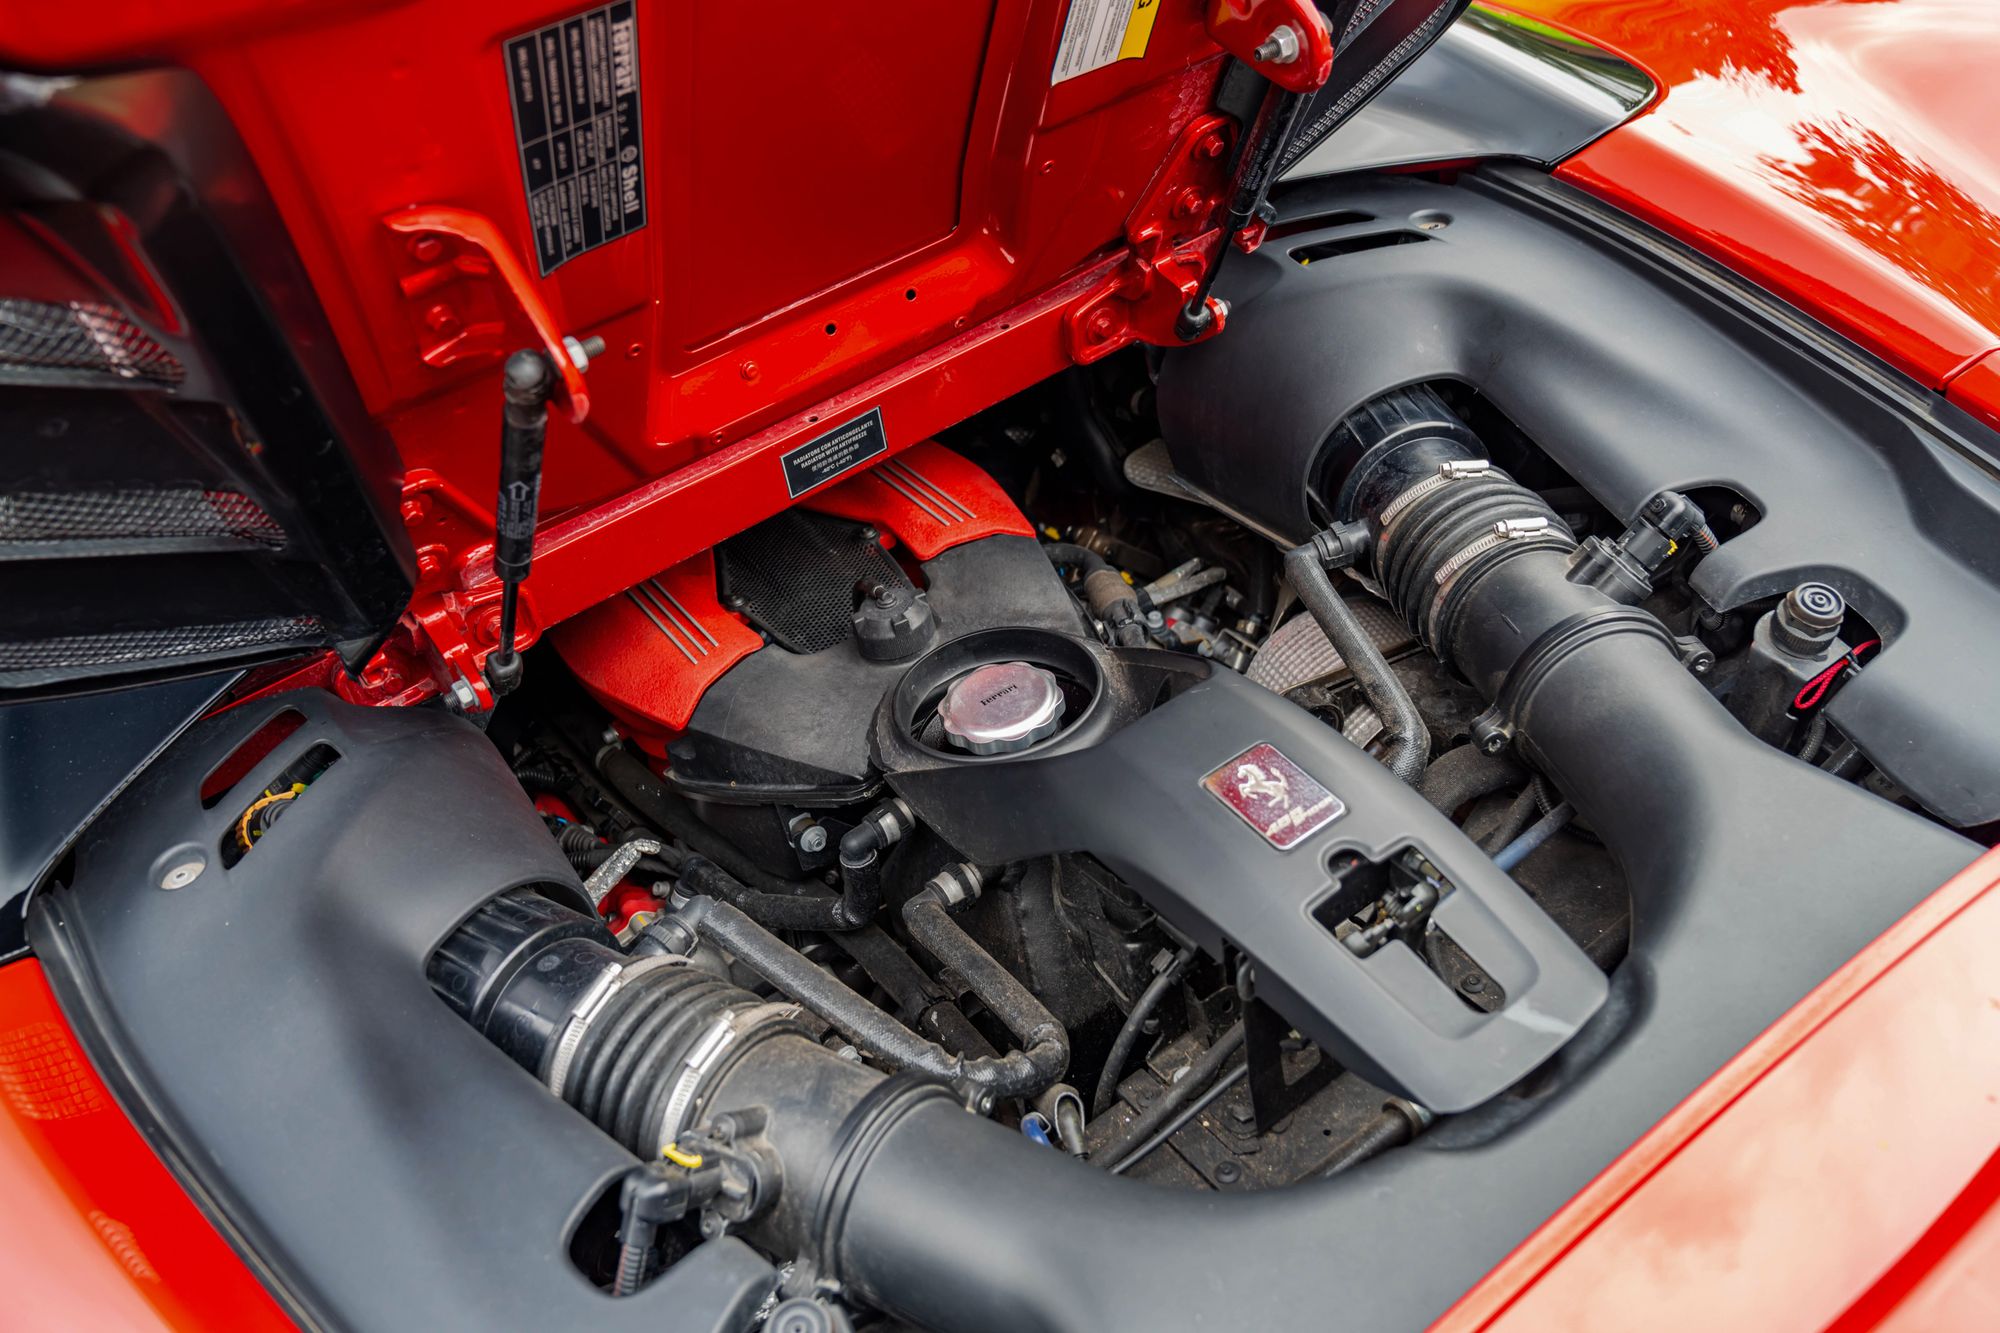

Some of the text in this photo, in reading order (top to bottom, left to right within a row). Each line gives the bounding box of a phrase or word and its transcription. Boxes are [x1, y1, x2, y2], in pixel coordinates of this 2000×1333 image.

[612, 17, 637, 97] Ferrari
[622, 163, 640, 214] Shell
[793, 420, 874, 466] RADIATORE CON ANTICONGELANTE
[800, 430, 868, 469] RADIATOR WITH ANTIFREEZE
[980, 684, 1018, 706] Ferrari
